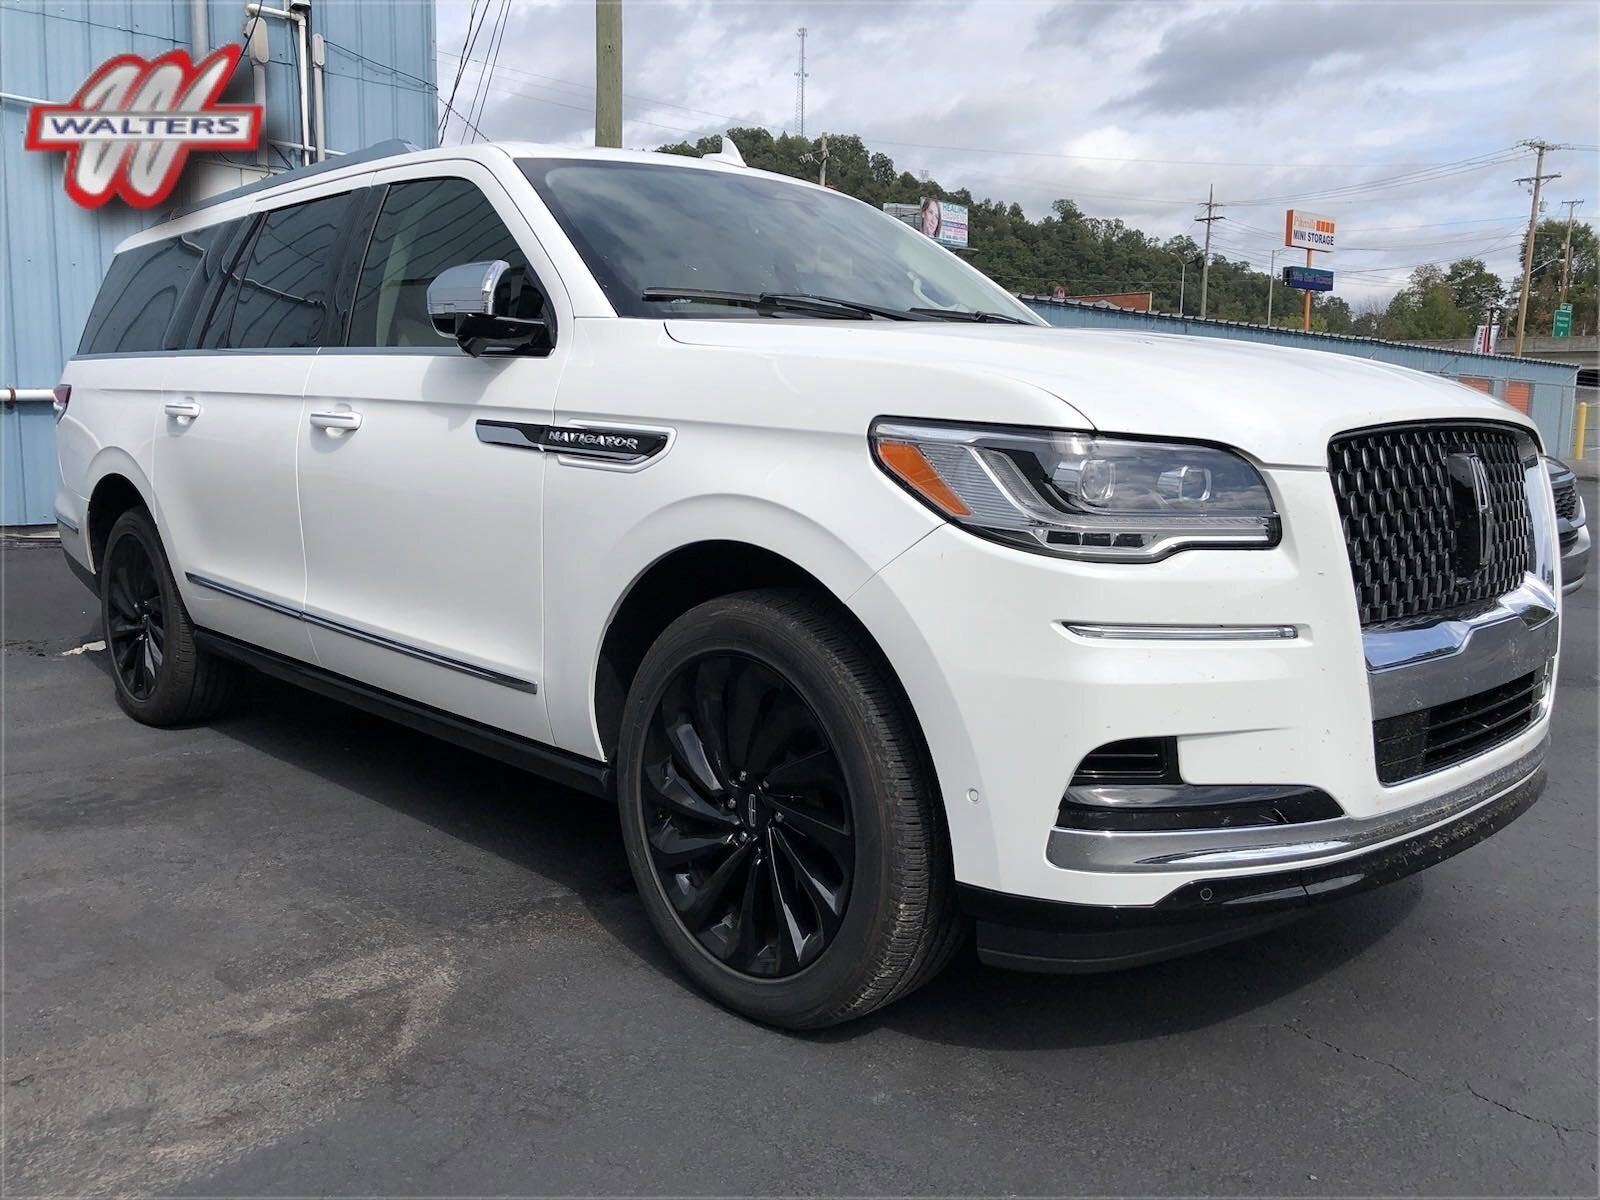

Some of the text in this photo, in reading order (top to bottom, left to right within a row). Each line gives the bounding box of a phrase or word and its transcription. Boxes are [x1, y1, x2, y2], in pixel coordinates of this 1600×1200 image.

[1293, 230, 1334, 246] MINI STORAGE
[548, 430, 639, 450] NAVIGATOR
